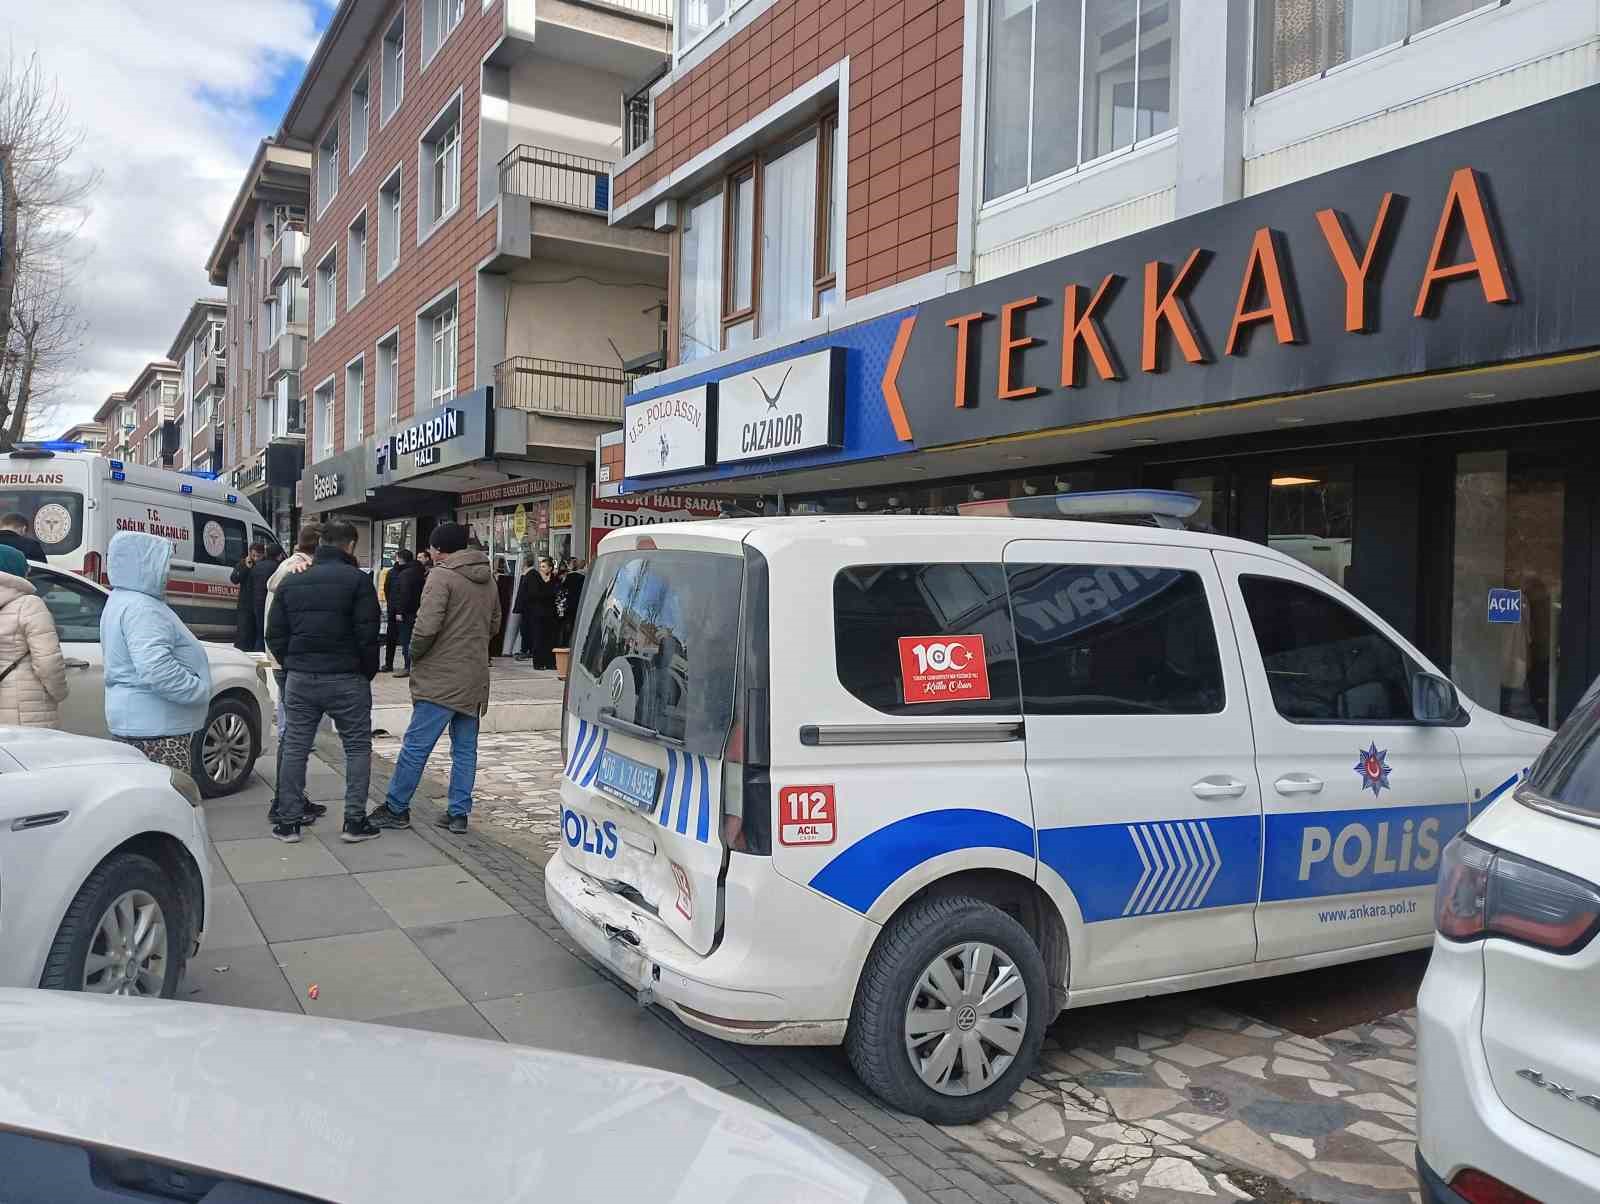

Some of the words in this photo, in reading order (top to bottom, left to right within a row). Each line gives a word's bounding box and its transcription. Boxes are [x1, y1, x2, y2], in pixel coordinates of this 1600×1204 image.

[945, 167, 1511, 410] TEKKAYA
[395, 407, 458, 455] GABARDİN
[629, 417, 646, 443] U.S.
[647, 400, 672, 425] POLO
[741, 413, 803, 454] CAZADOR
[0, 474, 64, 484] MBULANS
[313, 473, 338, 501] Baseus
[654, 495, 682, 509] HALI
[1489, 598, 1520, 614] AÇIK
[787, 791, 827, 820] 112
[1318, 900, 1417, 923] www.ankara.pol.tr
